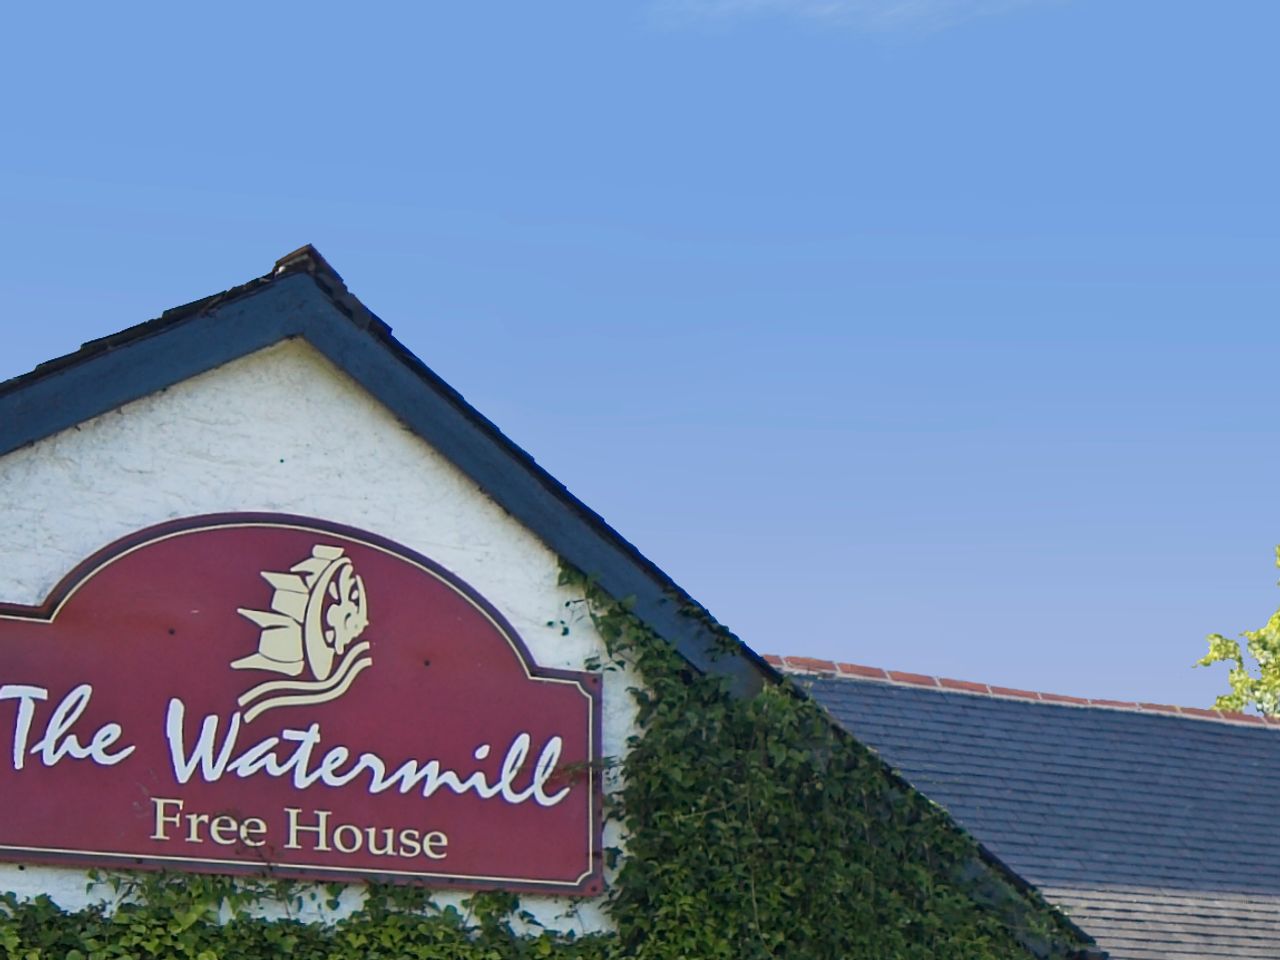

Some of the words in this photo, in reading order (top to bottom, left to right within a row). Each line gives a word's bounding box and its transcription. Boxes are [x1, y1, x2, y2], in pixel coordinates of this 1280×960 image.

[0, 684, 136, 770] The
[167, 698, 570, 806] Watermill
[150, 797, 267, 846] Free
[283, 807, 448, 859] House
